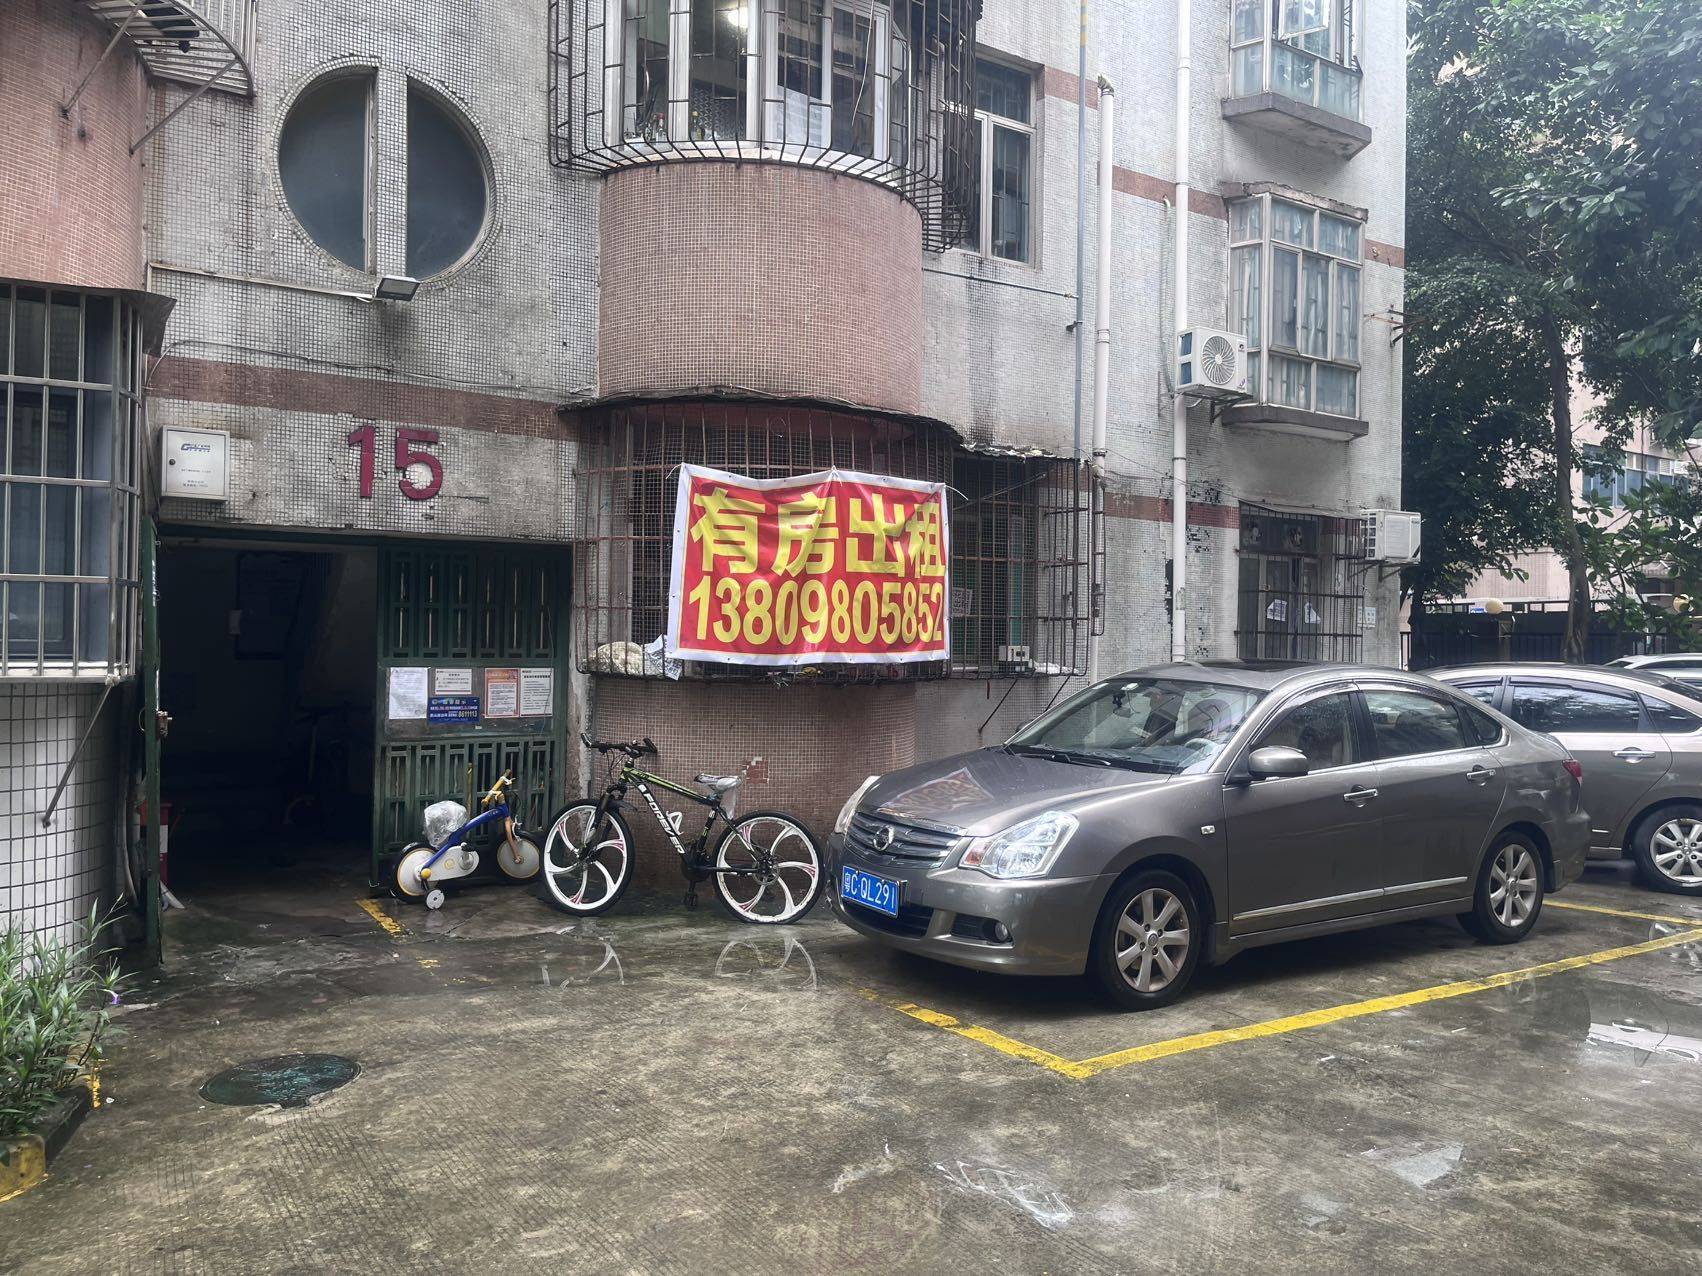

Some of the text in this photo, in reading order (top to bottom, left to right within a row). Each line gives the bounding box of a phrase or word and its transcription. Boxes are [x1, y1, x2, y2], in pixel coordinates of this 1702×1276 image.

[348, 425, 443, 500] 15
[690, 487, 946, 578] 有房出租
[689, 575, 944, 646] 13809805852
[644, 793, 686, 854] FOREVER
